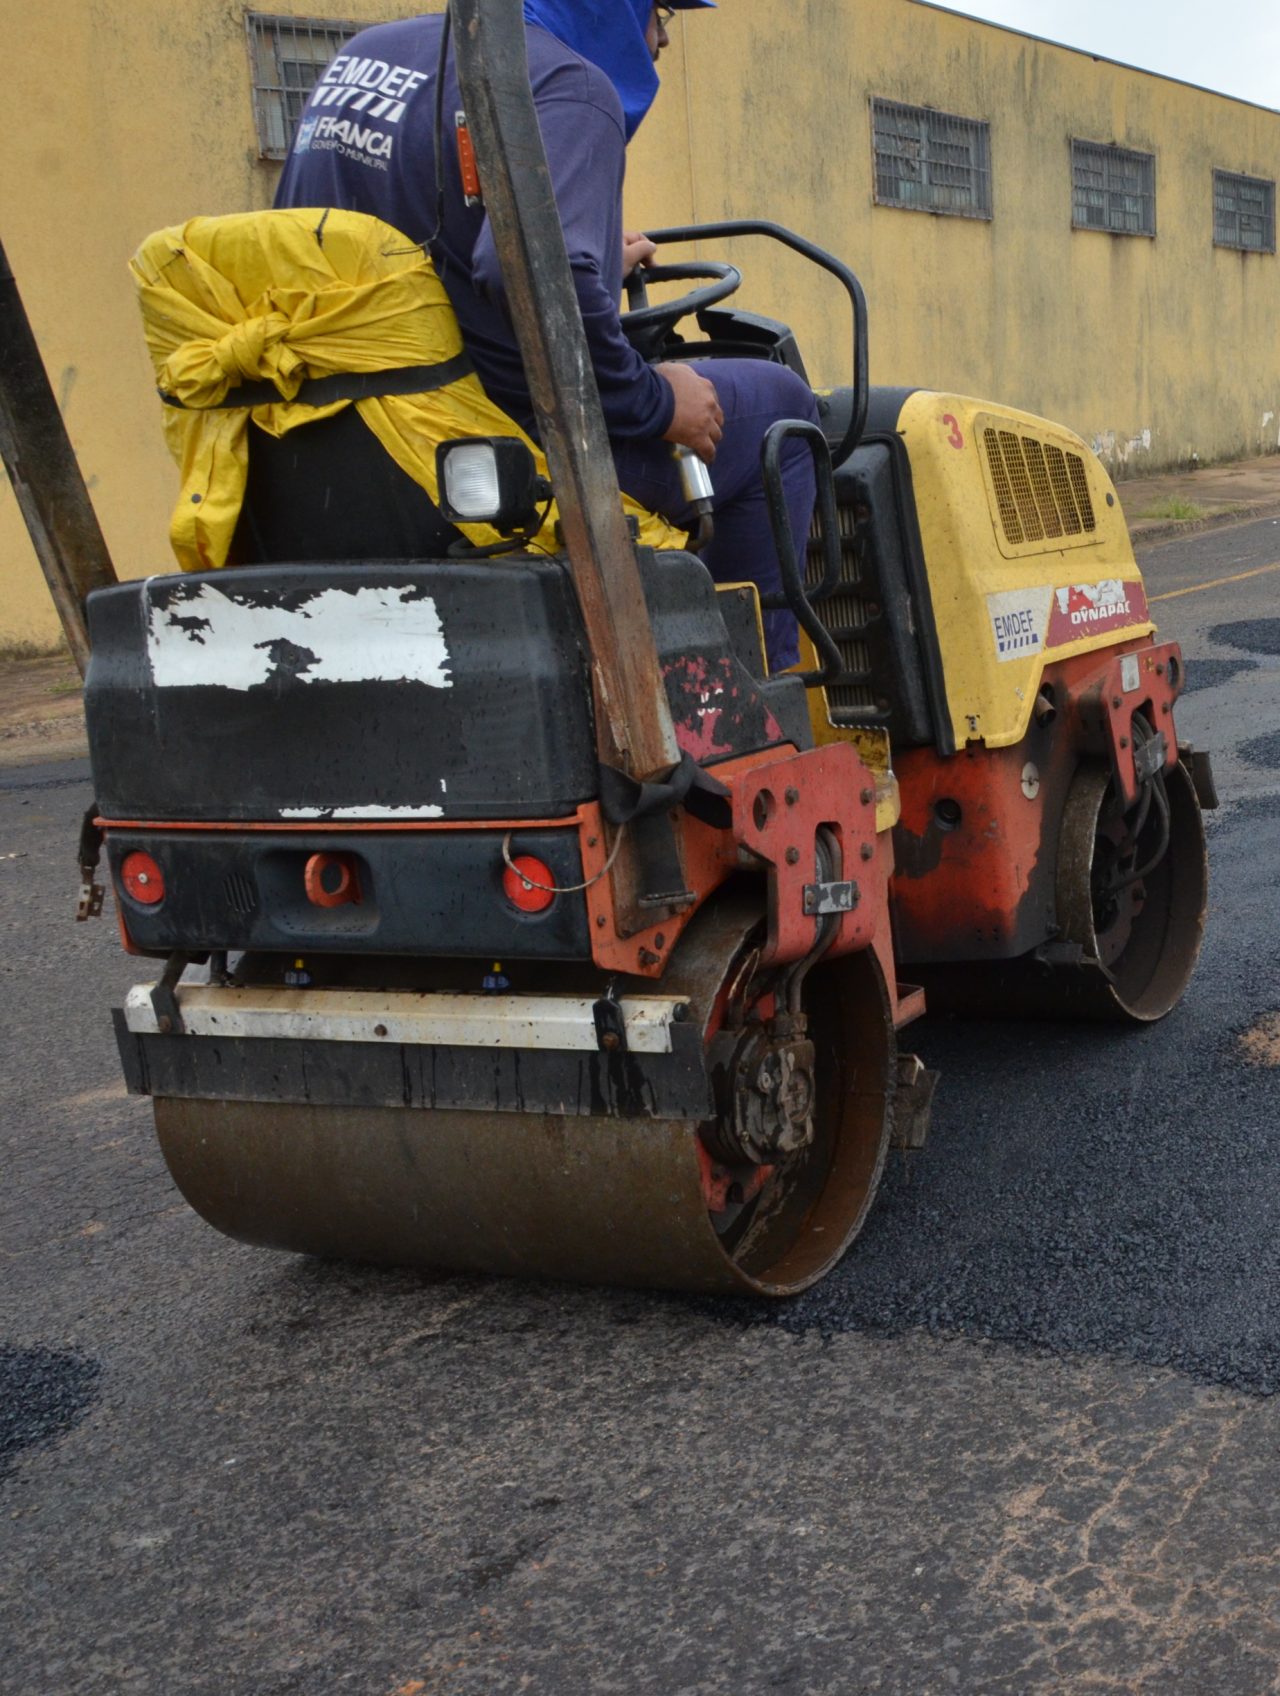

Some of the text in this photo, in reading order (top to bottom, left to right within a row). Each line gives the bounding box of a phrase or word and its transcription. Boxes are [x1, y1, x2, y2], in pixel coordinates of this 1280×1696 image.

[322, 55, 428, 98] EMDEF
[314, 116, 393, 159] FRANCA
[943, 414, 964, 449] 3
[994, 609, 1033, 639] EMDEF
[1071, 600, 1131, 624] DYNAPAC
